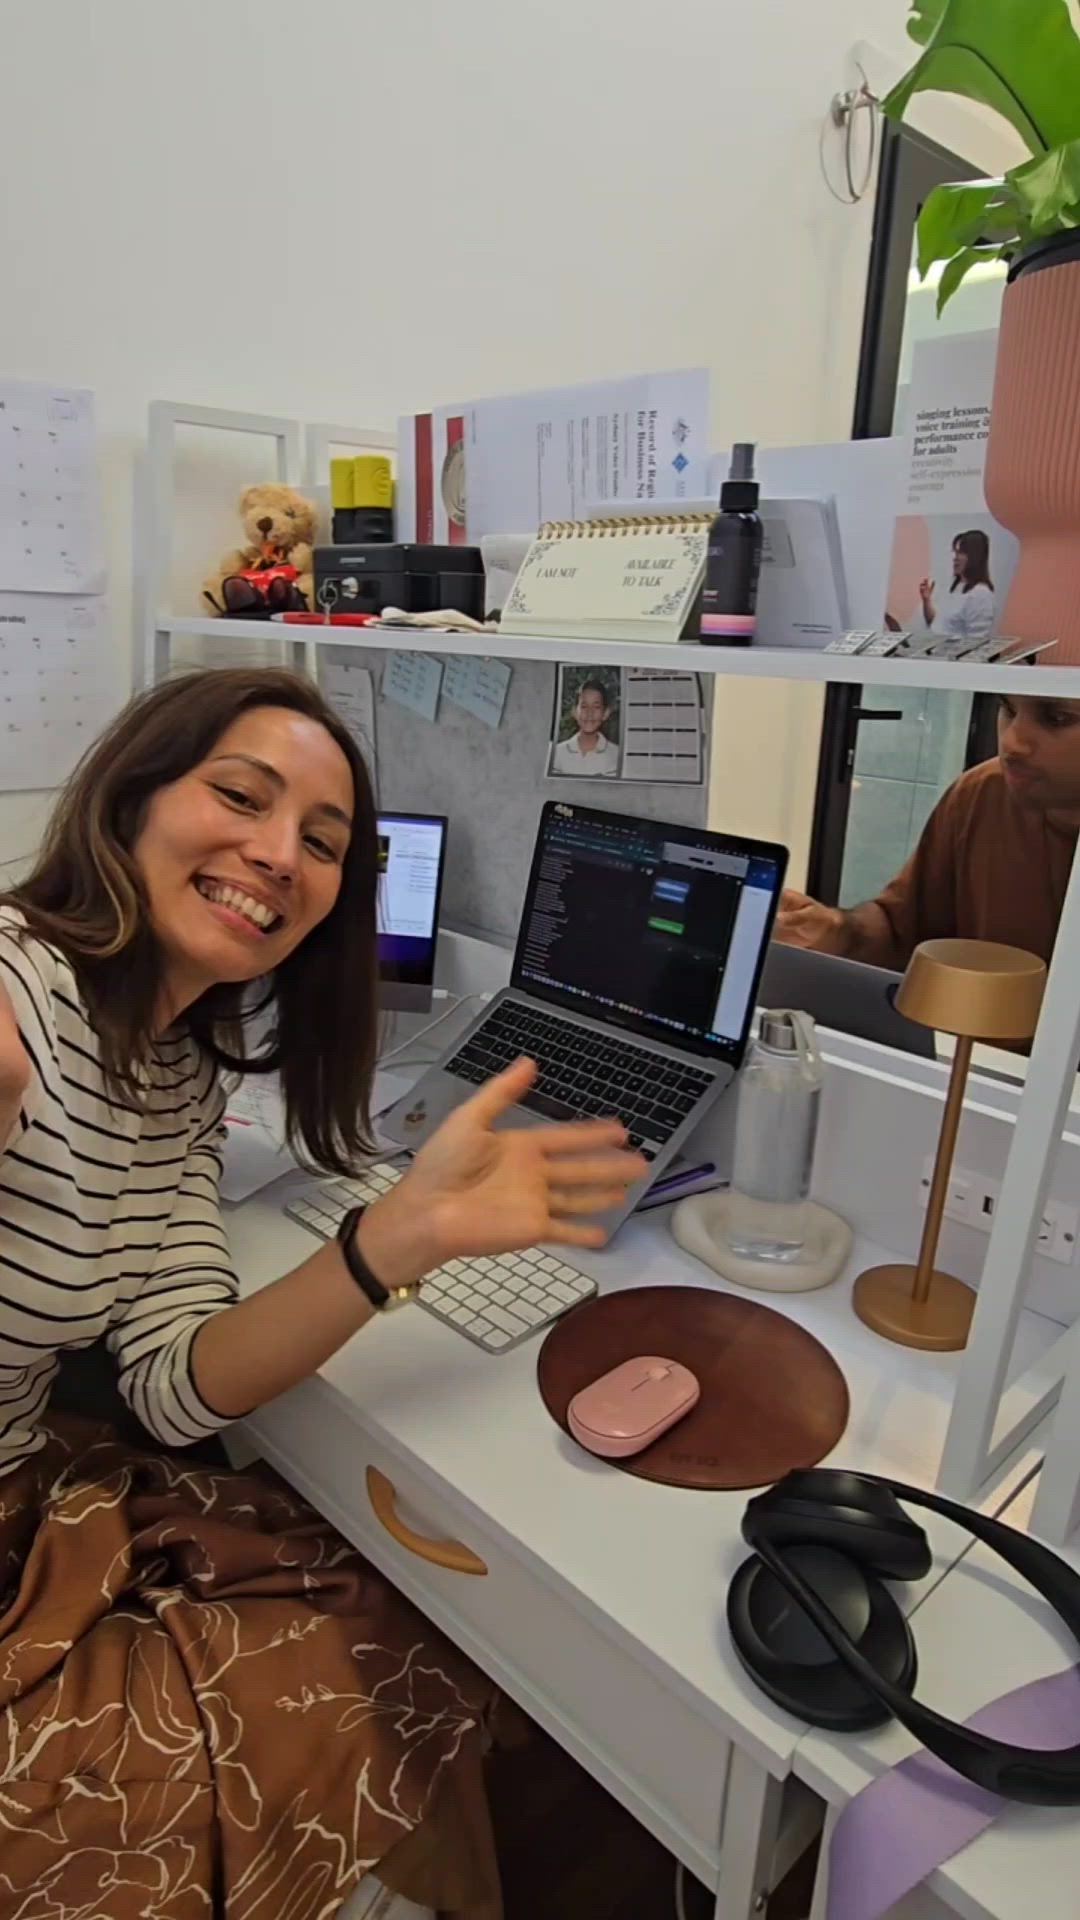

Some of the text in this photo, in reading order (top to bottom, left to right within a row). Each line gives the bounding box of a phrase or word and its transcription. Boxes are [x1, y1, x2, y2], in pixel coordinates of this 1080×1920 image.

[917, 408, 951, 420] singing
[646, 411, 657, 451] Record
[916, 422, 939, 432] voice
[941, 418, 980, 430] training
[914, 432, 976, 447] performance
[638, 432, 646, 480] Business
[912, 444, 958, 456] for adults
[647, 454, 656, 466] of
[625, 559, 677, 570] AVAILABLE
[536, 568, 579, 578] I AM NOT
[622, 576, 664, 587] TO TALK
